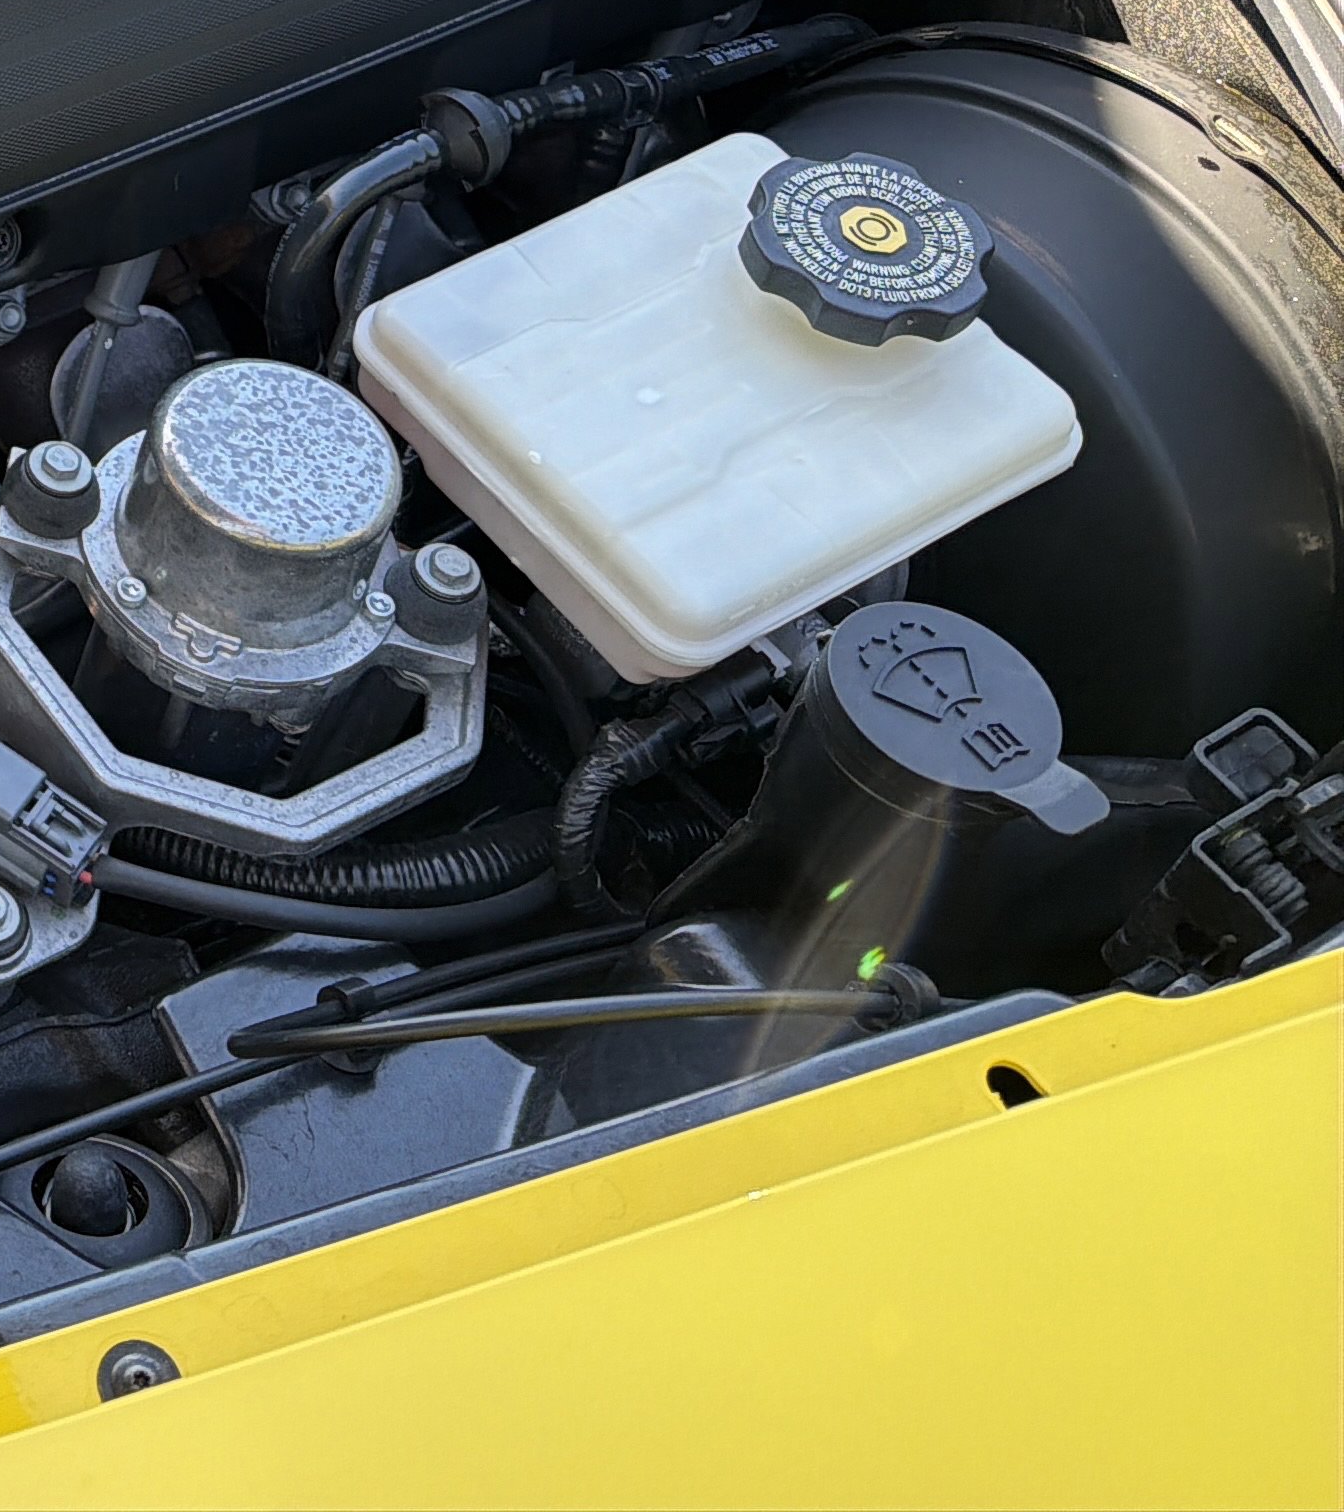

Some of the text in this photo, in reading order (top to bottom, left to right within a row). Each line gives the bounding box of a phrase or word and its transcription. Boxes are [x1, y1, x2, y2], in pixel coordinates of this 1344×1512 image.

[790, 162, 841, 187] BOUCHON
[840, 162, 880, 175] AVANT
[881, 168, 898, 183] LA
[781, 180, 799, 195] LE
[807, 174, 846, 195] LIQUIDE
[845, 173, 864, 185] DE
[865, 175, 902, 194] FREIN
[794, 189, 812, 205] DU
[901, 188, 934, 210] DOT3
[772, 191, 791, 234] NETTOYER
[790, 201, 807, 221] QUE
[808, 209, 849, 263] PROVENANT
[829, 185, 867, 199] BIDON
[927, 211, 953, 233] ONLY
[852, 214, 939, 277] WARNING: CLEAN FILLER
[940, 234, 958, 252] USE
[783, 237, 838, 283] ATTENTION:
[842, 267, 868, 283] CAP
[944, 257, 974, 288] SEALED
[838, 278, 872, 299] DOT3
[868, 275, 918, 290] BEFORE
[939, 281, 953, 293] A
[874, 288, 911, 303] FLUID
[909, 284, 945, 302] FROM
